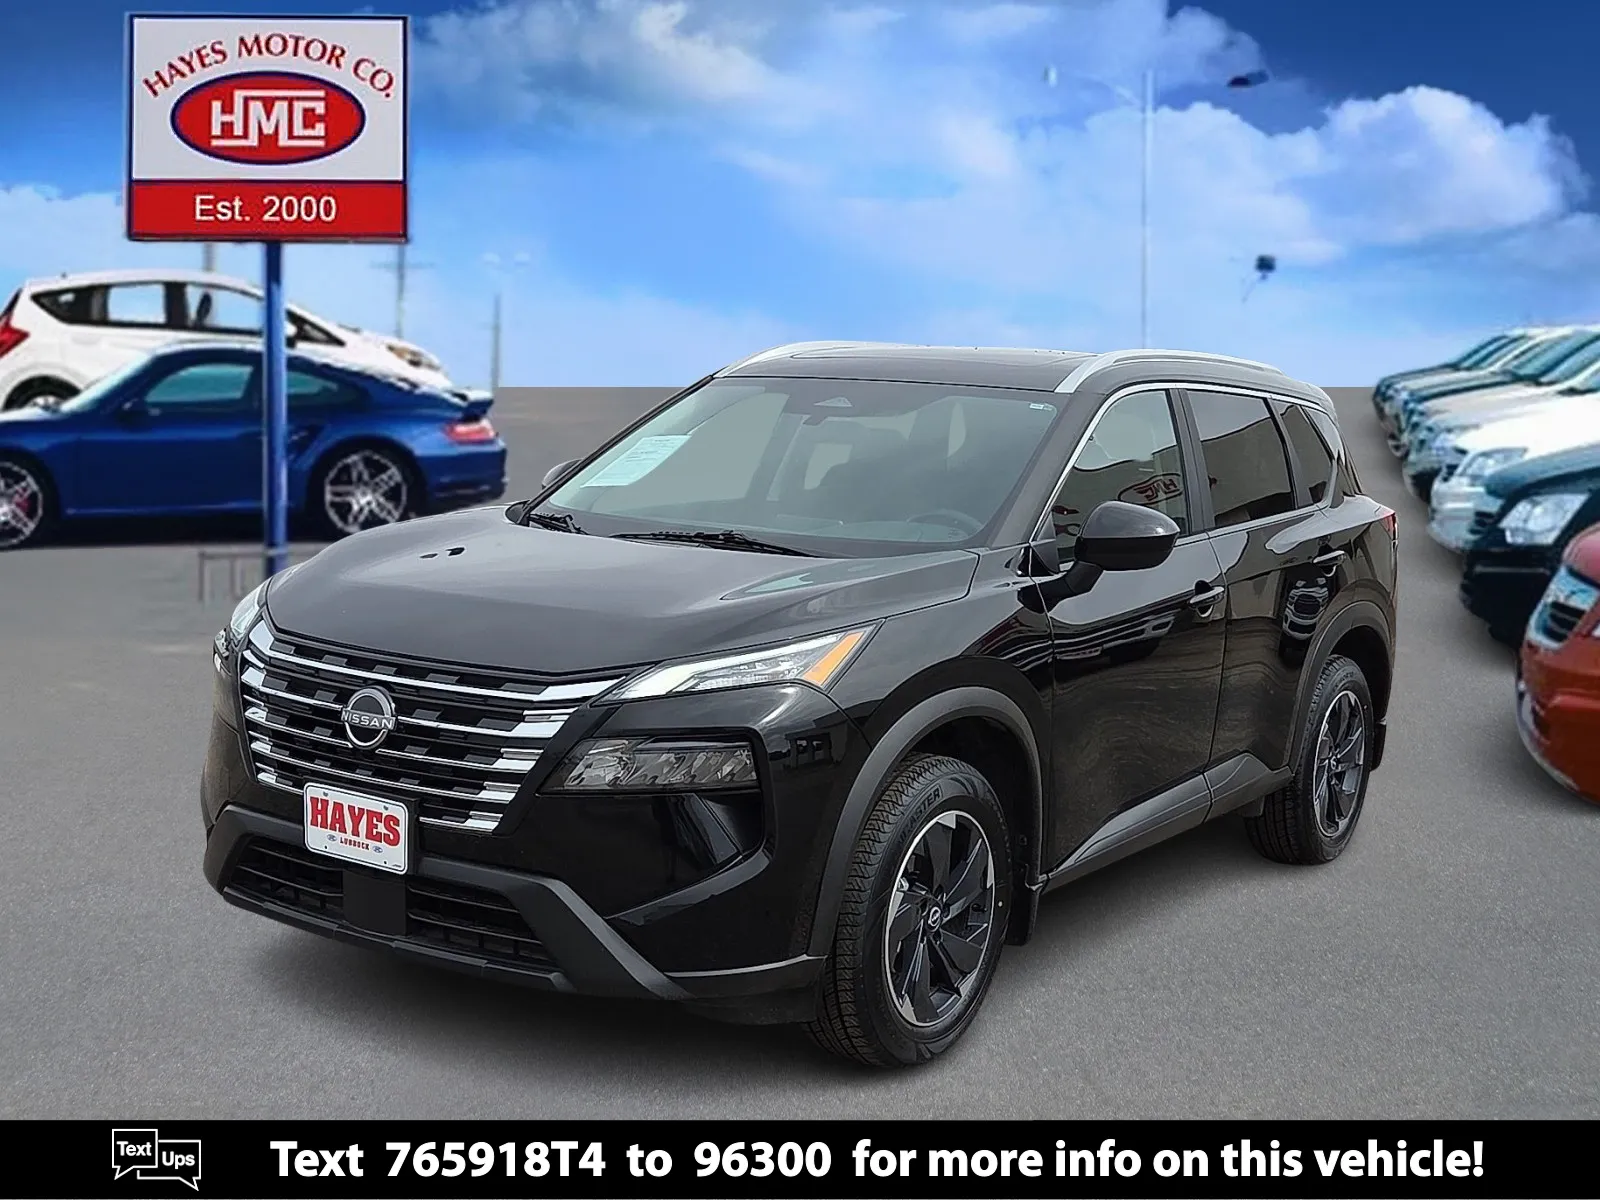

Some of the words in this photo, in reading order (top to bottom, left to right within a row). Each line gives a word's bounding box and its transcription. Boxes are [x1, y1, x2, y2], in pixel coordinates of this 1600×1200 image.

[142, 40, 229, 98] HAYES
[237, 33, 347, 69] MOTOR
[352, 57, 395, 98] CO.
[210, 89, 326, 147] HMC
[194, 195, 251, 222] Est.
[262, 195, 338, 222] 2000
[342, 710, 395, 730] NISSAN
[309, 796, 401, 847] HAYES
